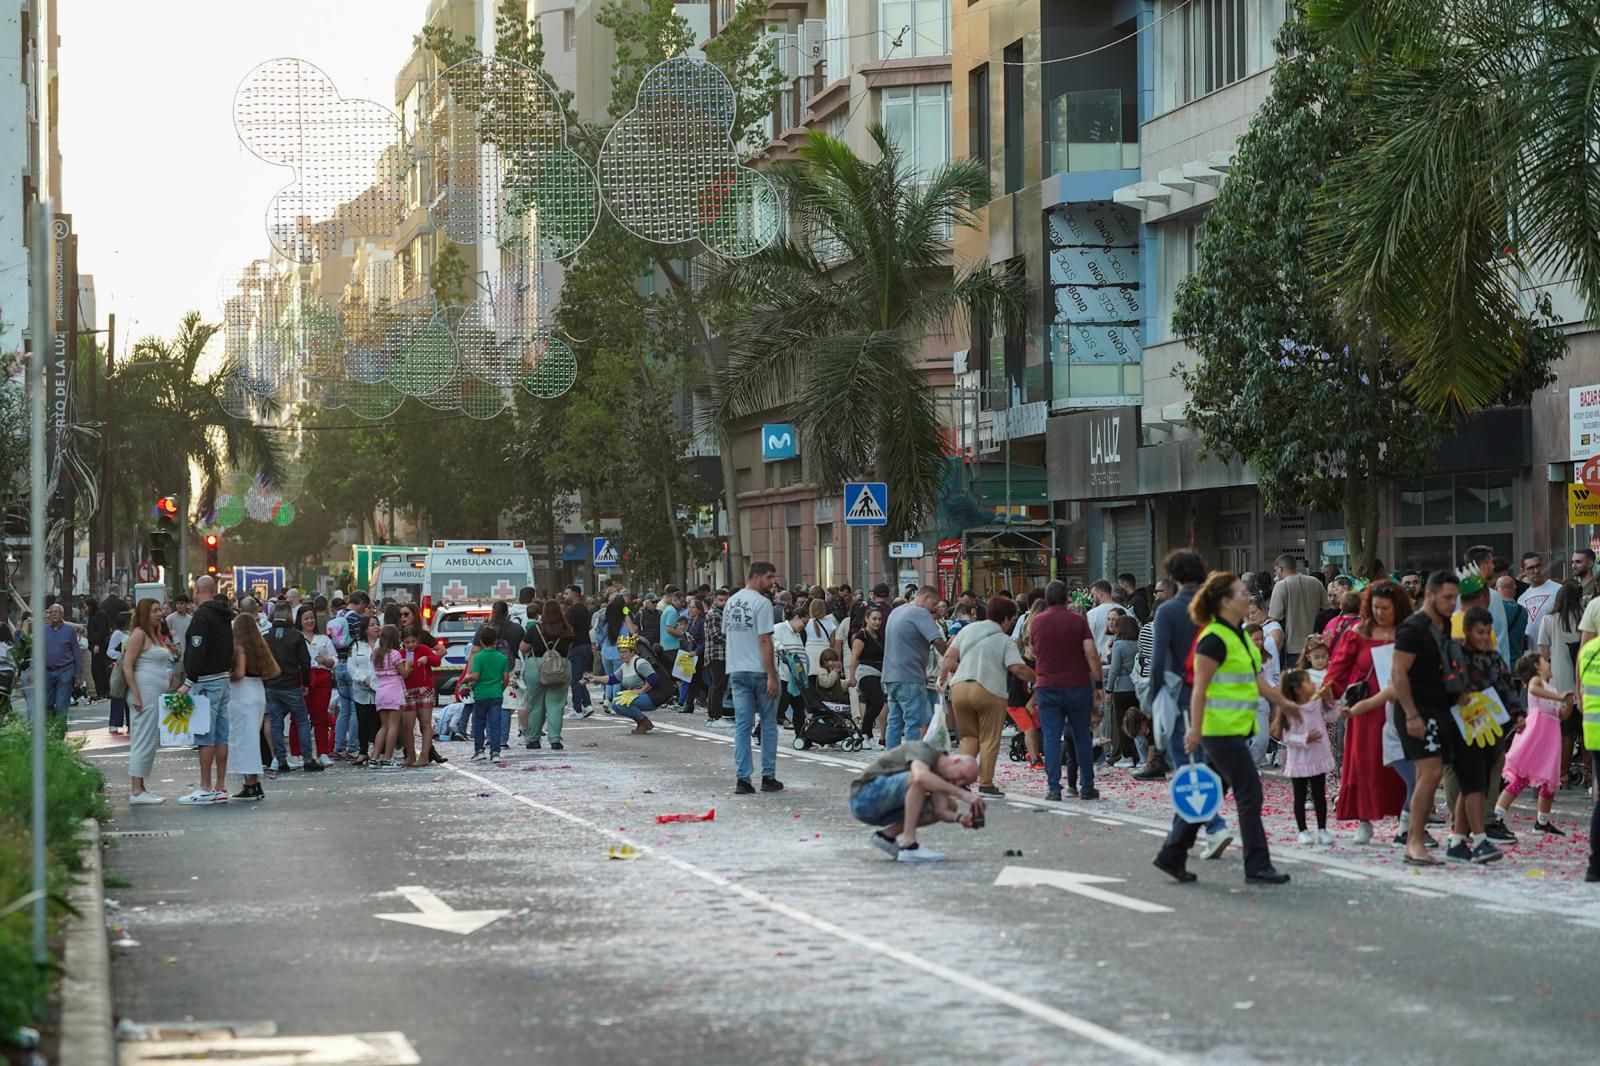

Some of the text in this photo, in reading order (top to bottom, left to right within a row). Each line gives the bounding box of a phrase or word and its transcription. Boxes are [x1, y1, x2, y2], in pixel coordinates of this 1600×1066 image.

[1094, 218, 1114, 244] BOND
[1067, 286, 1088, 312] BOND
[1107, 329, 1128, 356] BOND
[55, 359, 66, 376] LA
[55, 379, 66, 396] DE
[1090, 420, 1103, 465] LA
[1103, 416, 1121, 464] LUZ
[1574, 510, 1598, 518] Union
[445, 558, 513, 566] AMBULANCIA
